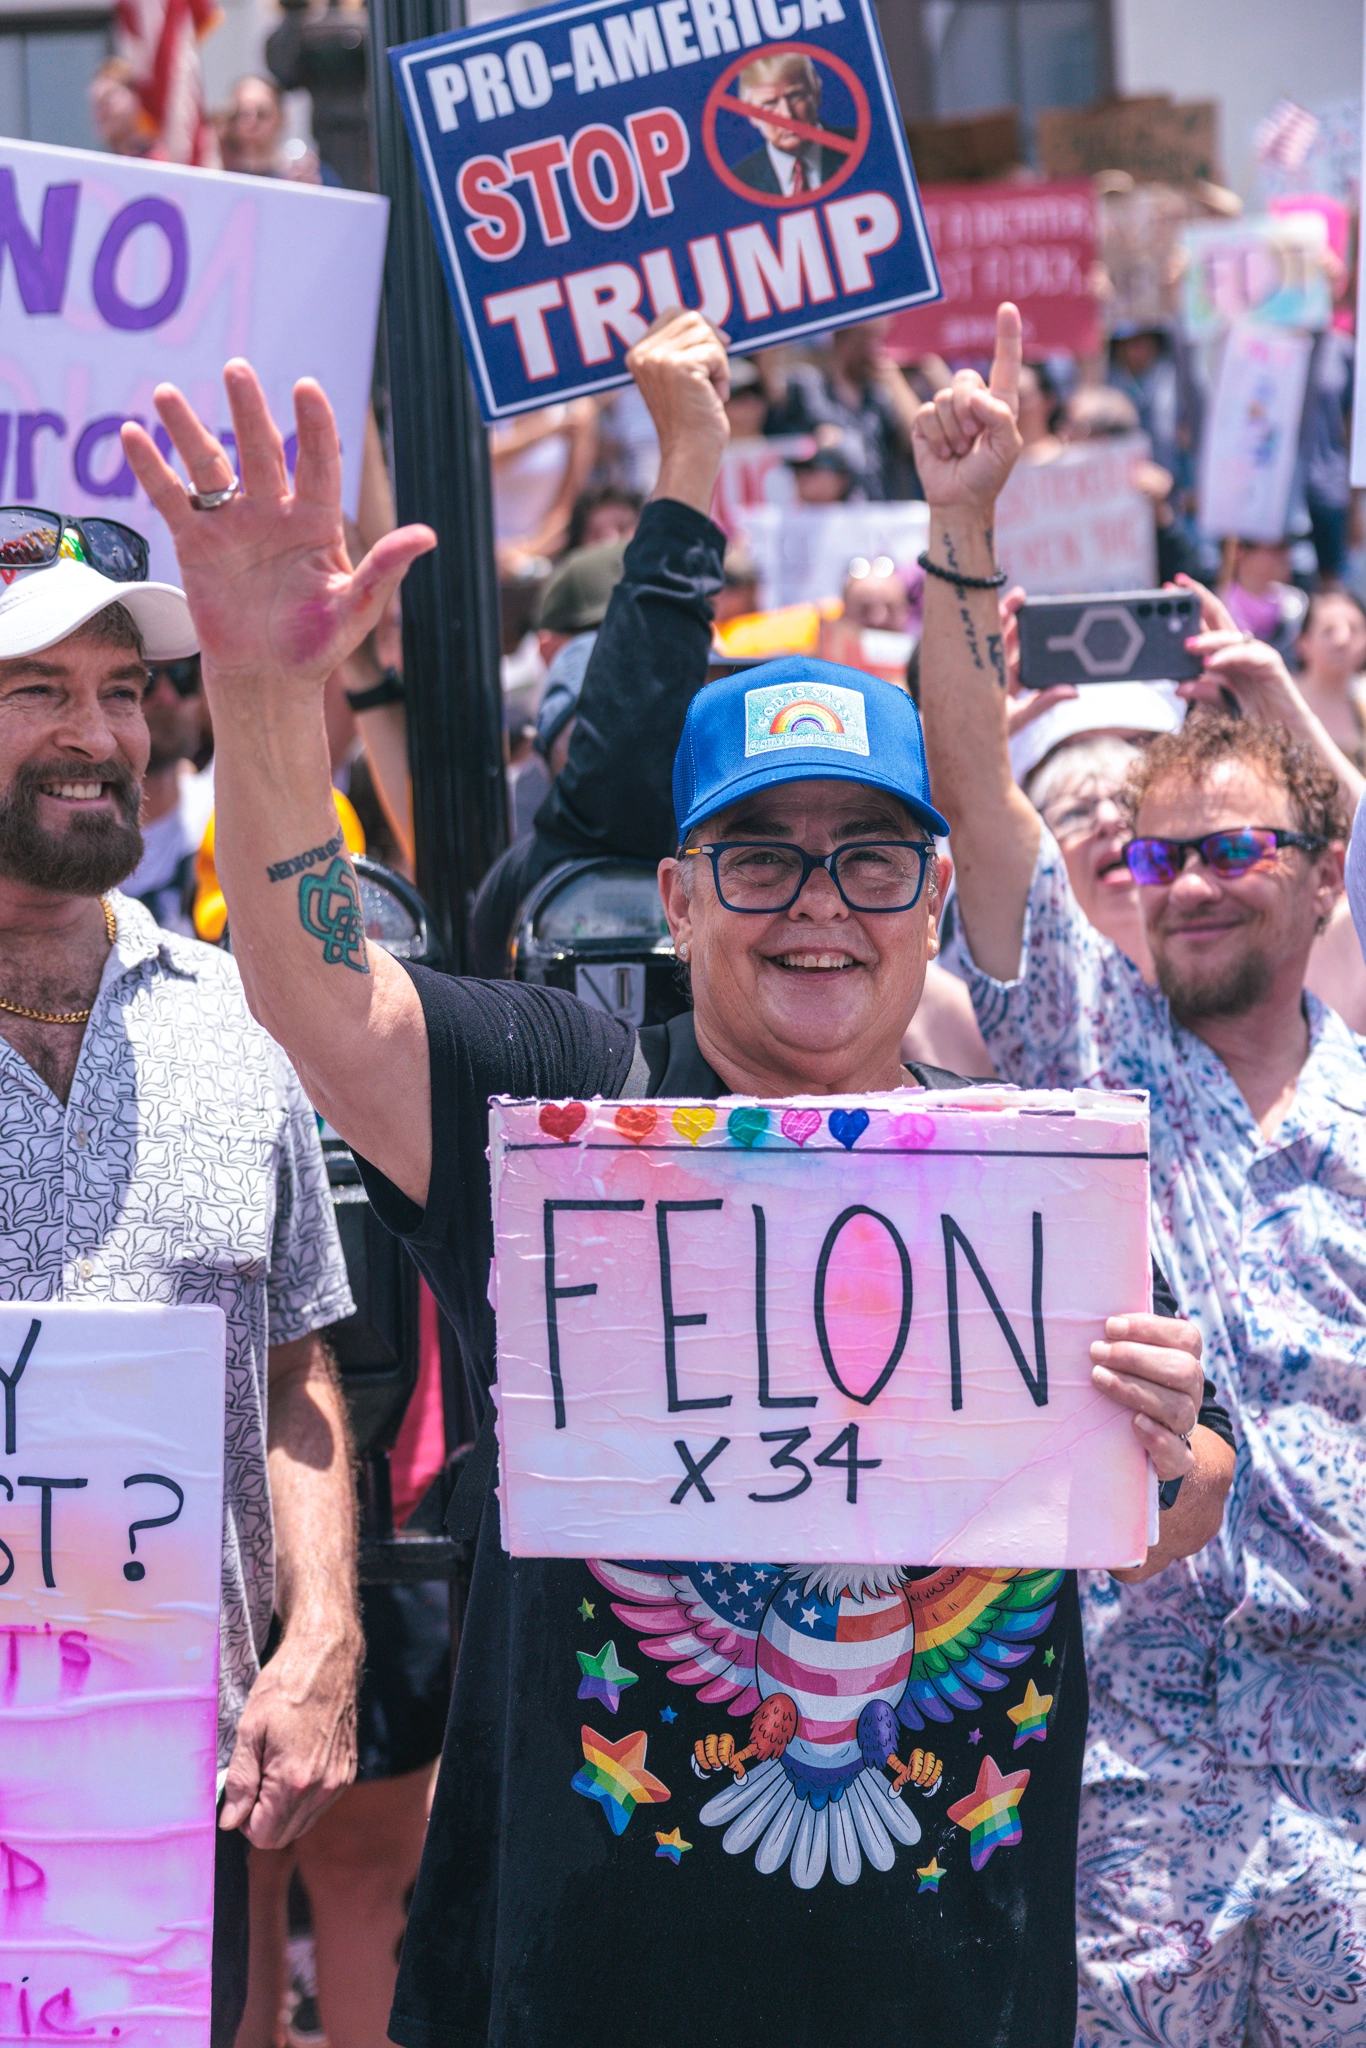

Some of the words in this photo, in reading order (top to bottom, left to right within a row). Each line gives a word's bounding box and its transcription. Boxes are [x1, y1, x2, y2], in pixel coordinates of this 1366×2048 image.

[426, 0, 847, 134] PRO-AMERICA
[0, 167, 188, 332] NO
[456, 106, 691, 263] STOP
[484, 190, 902, 383] TRUMP
[758, 696, 785, 728] GOD
[786, 685, 806, 700] IS
[810, 685, 857, 728] SASSY
[543, 1197, 1048, 1429] FELON
[748, 1422, 882, 1505] 34
